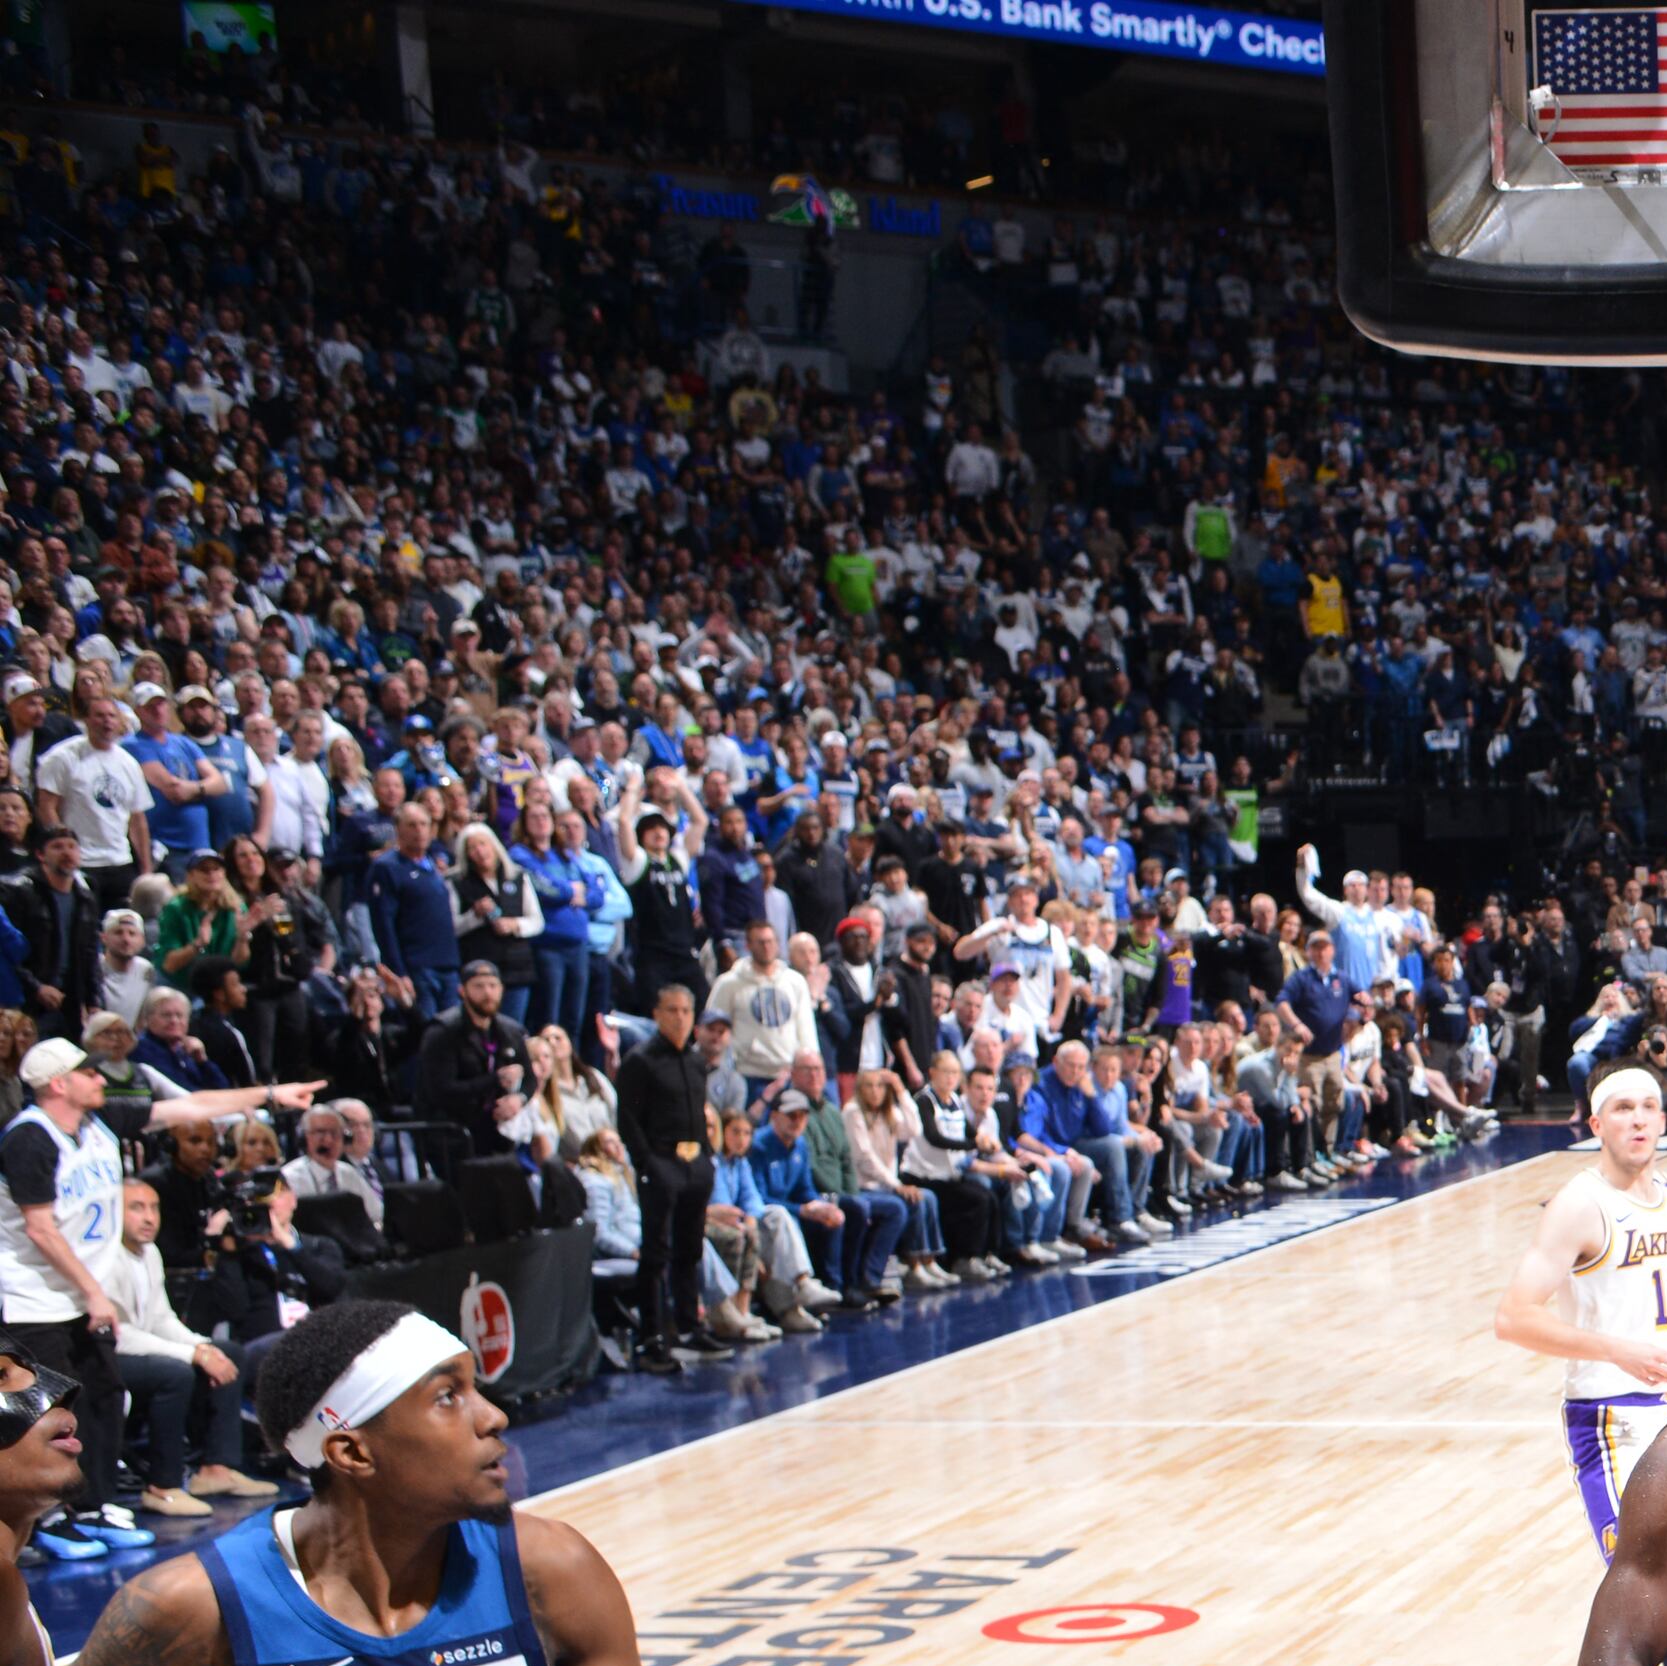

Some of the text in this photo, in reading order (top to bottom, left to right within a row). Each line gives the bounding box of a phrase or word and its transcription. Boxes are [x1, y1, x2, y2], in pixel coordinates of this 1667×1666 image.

[923, 0, 983, 21] U.S.
[1002, 0, 1082, 33] Bank
[1238, 29, 1324, 64] Chec
[443, 1638, 504, 1665] sezzle
